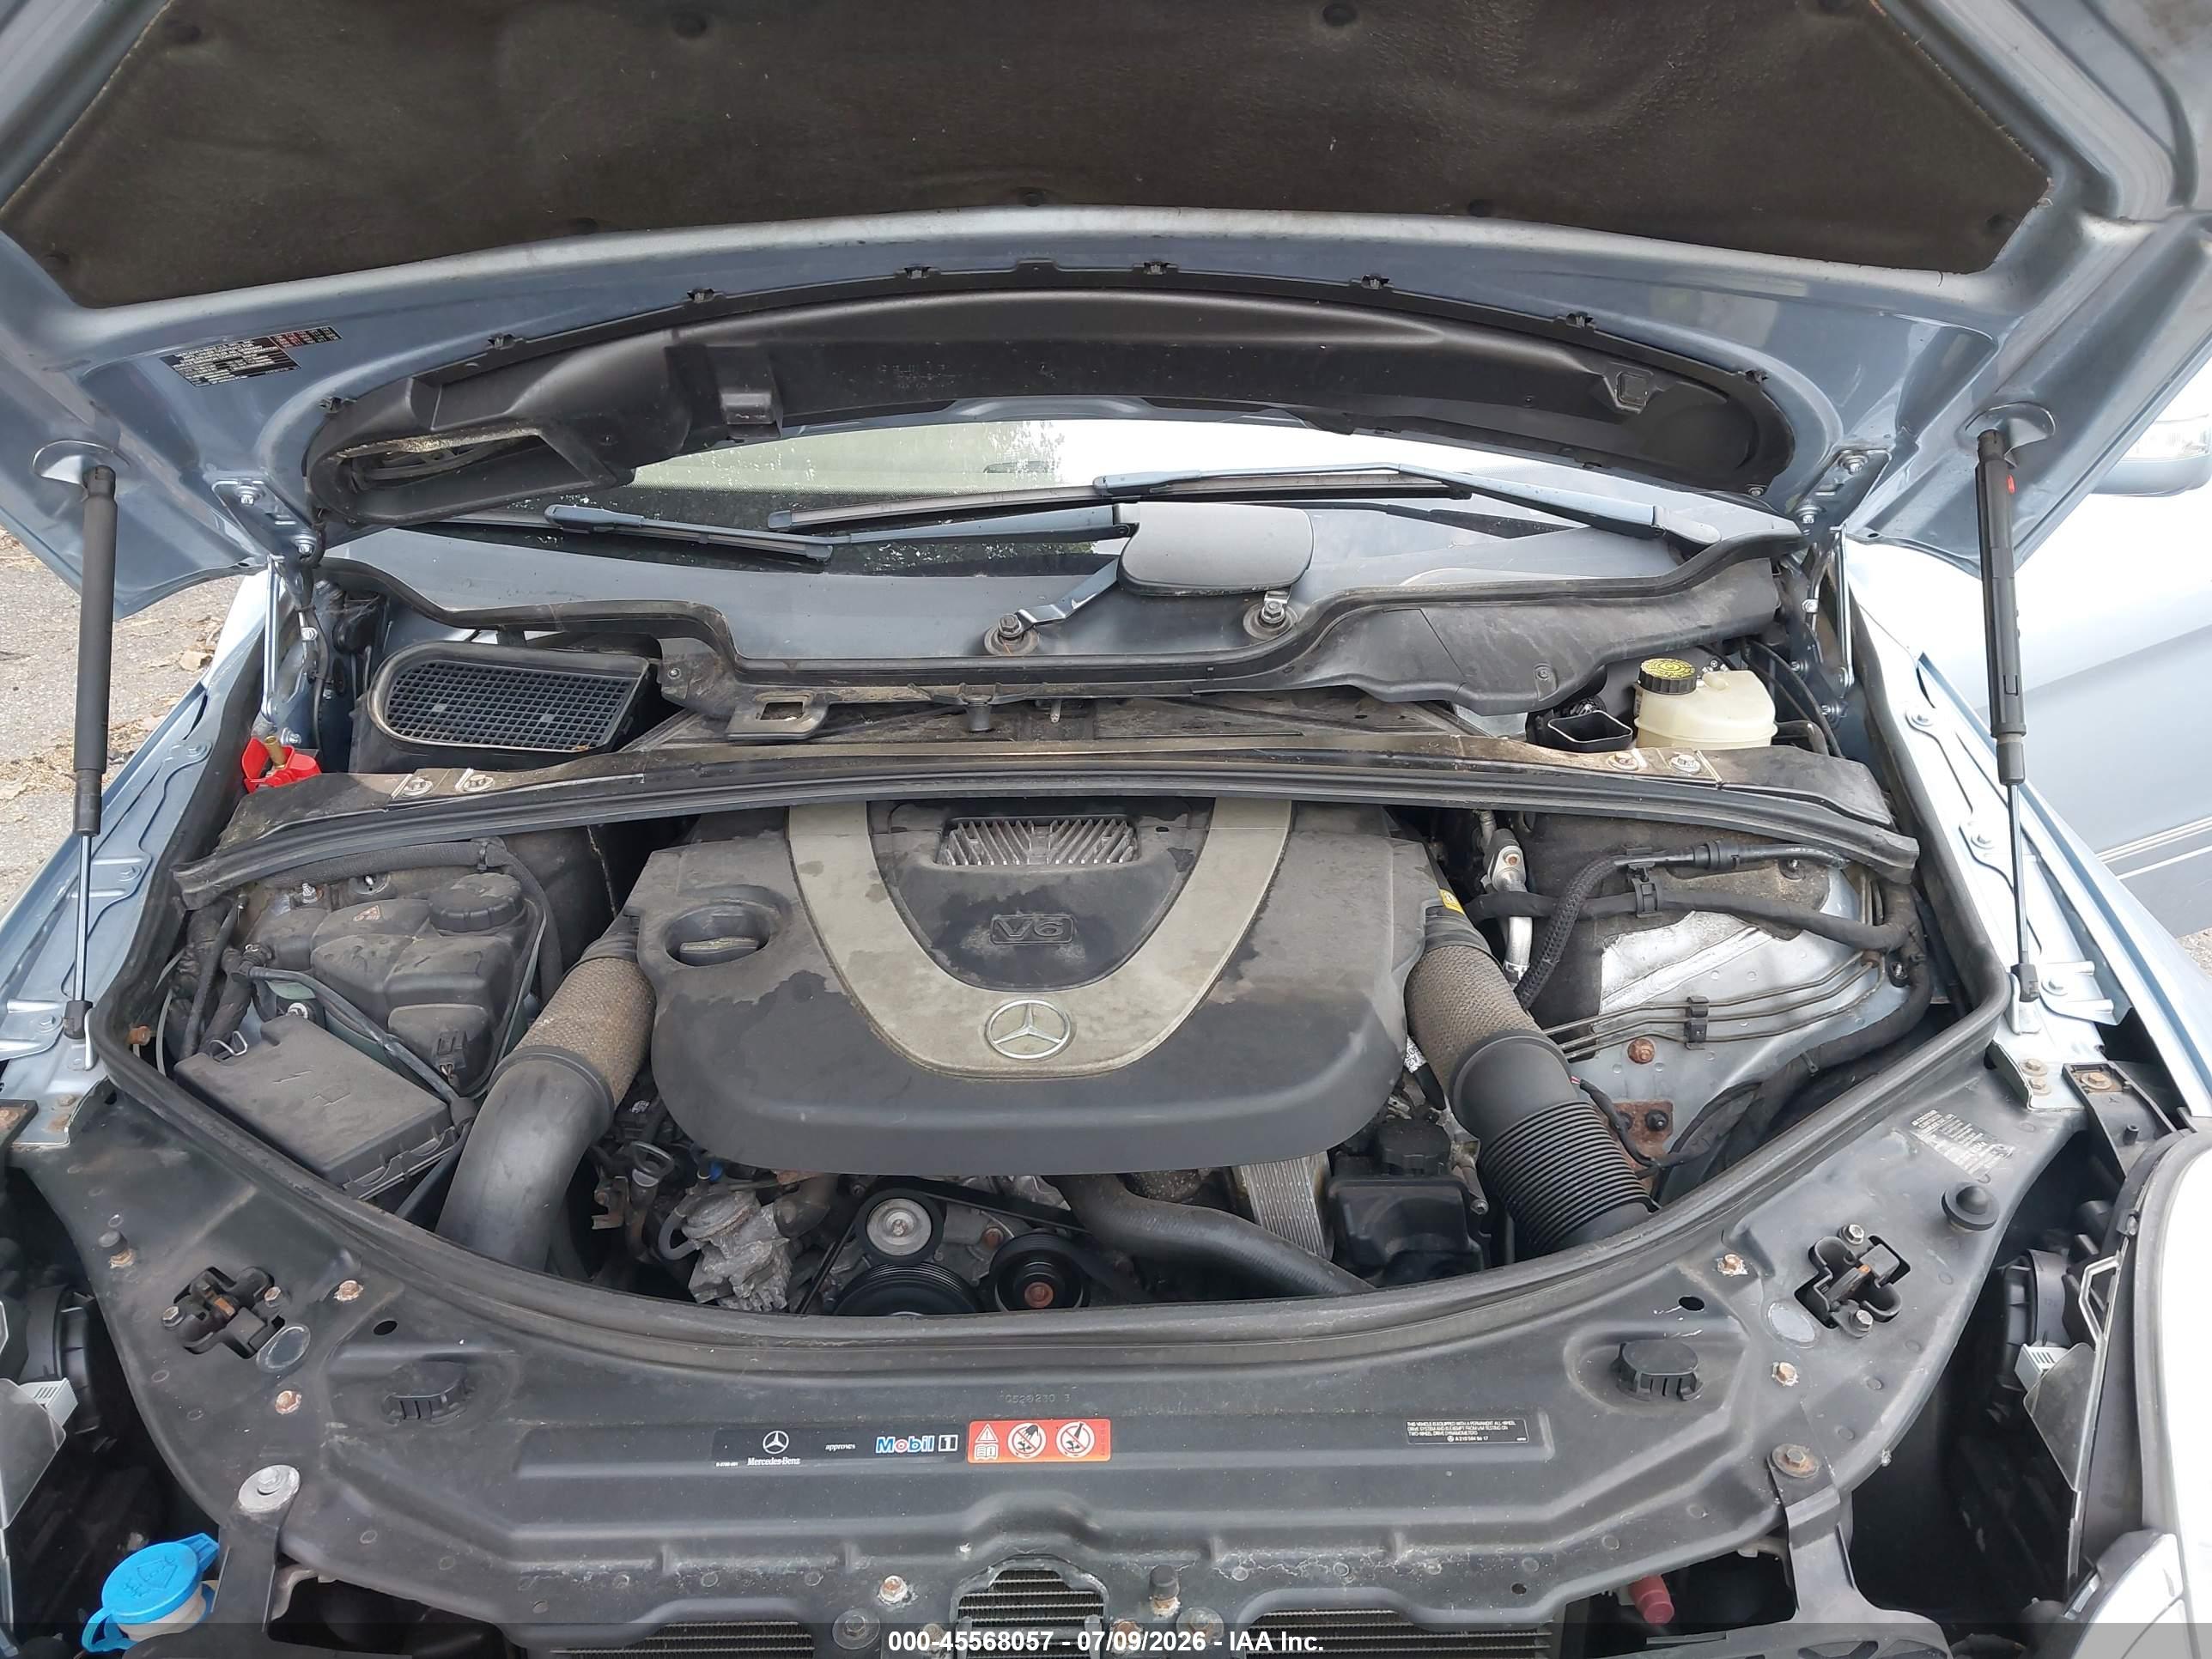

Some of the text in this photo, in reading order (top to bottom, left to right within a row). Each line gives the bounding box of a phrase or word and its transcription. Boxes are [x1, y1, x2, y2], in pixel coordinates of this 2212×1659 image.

[996, 920, 1065, 940] V6
[876, 1436, 935, 1453] Mobil
[747, 1457, 800, 1466] Mercedes-Benz
